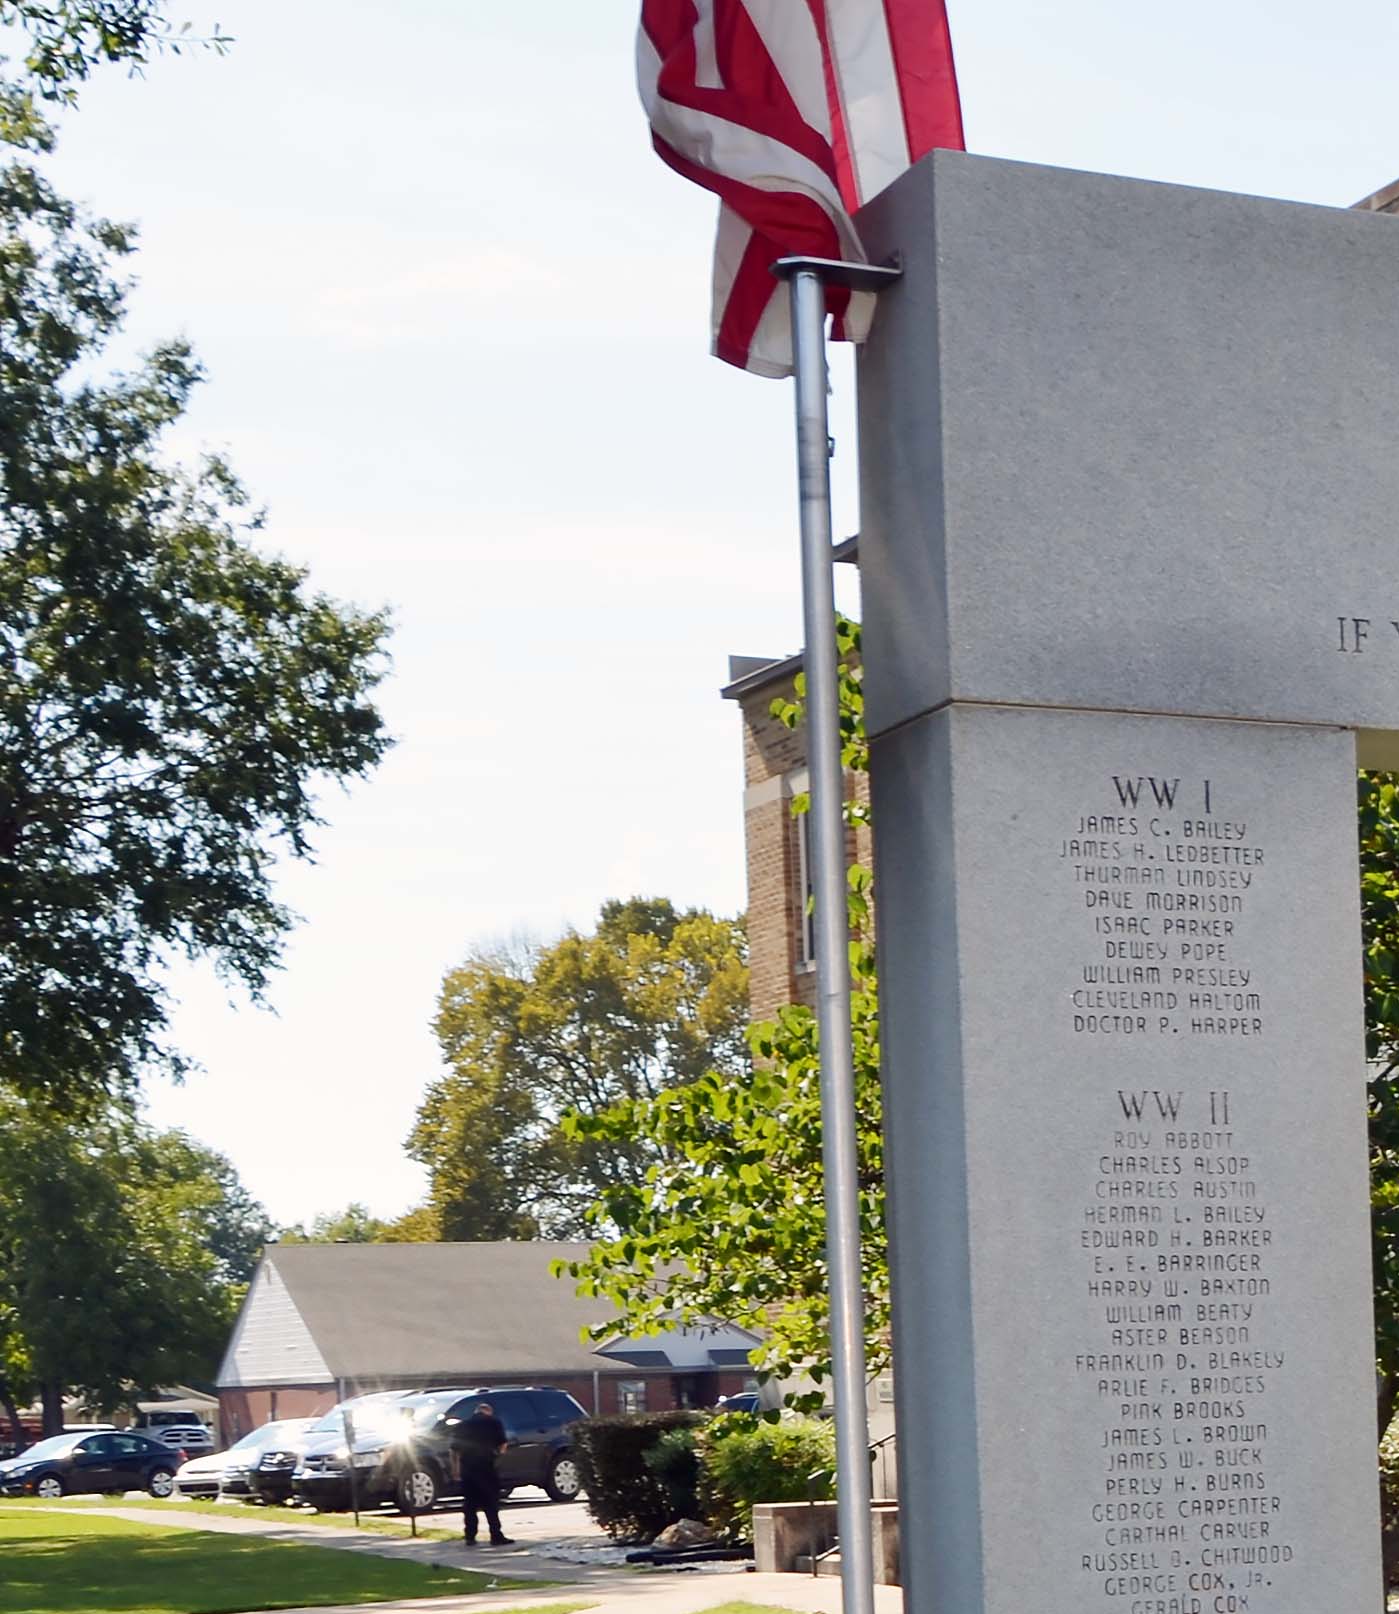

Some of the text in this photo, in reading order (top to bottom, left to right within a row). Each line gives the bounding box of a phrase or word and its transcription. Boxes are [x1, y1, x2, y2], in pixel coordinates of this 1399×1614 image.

[1337, 616, 1368, 652] IF
[1112, 777, 1212, 813] WW I
[1077, 817, 1246, 840] JAMES C. BAILEY
[1059, 840, 1264, 865] JAMES H. LEDBETTER
[1074, 865, 1252, 889] THURMAN LINDSEY
[1086, 891, 1242, 912] DAVE MORRISON
[1096, 917, 1234, 936] ISAAC PARKER
[1106, 942, 1225, 961] DEWEY POPE
[1083, 966, 1250, 987] WILLIAM PRESLEY
[1072, 991, 1260, 1010] CLEVELAND HALTOM
[1074, 1016, 1262, 1035] DOCTOR P. HARPER
[1117, 1091, 1230, 1125] WW II
[1114, 1132, 1232, 1150] ROY ABBOTT
[1100, 1157, 1249, 1174] CHARLES ALSOP
[1096, 1181, 1255, 1198] CHARLES AUSTIN
[1082, 1231, 1272, 1247] EDWARD H. BARKER
[1095, 1255, 1260, 1273] E. E. BARRINGER
[1089, 1279, 1270, 1297] HARRY W. BAXTON
[1107, 1304, 1252, 1323] WILLIAM BEATY
[1112, 1327, 1248, 1346] ASTER BEASON
[1121, 1400, 1245, 1419] PINK BROOKS
[1106, 1473, 1265, 1495] PERLY H. BURNS
[1092, 1497, 1280, 1522] GEORGE CARPENTER
[1200, 1522, 1270, 1541] CARVER
[1214, 1595, 1249, 1613] COX
